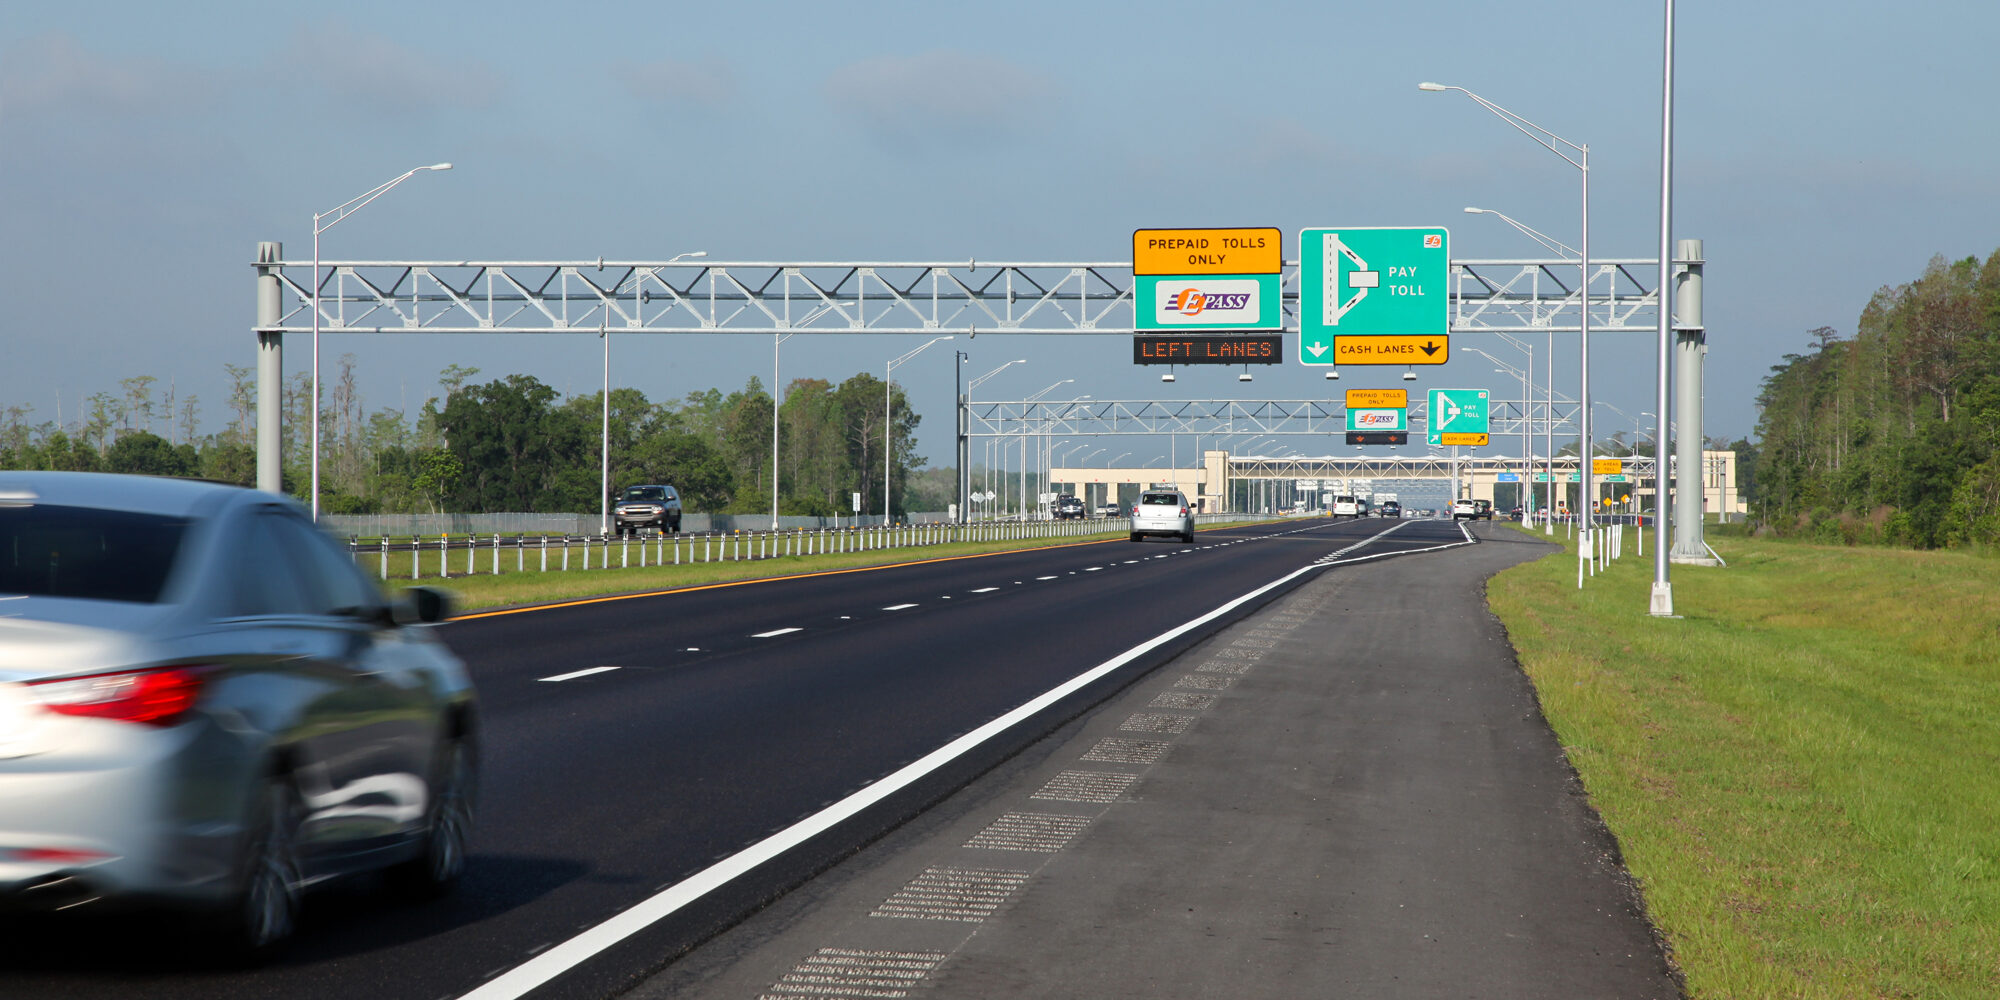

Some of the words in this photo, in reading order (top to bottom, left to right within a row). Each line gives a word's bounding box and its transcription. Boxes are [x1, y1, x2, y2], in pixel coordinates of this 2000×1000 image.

[1149, 239, 1209, 249] PREPAID
[1223, 238, 1265, 248] TOLLS
[1188, 254, 1226, 265] ONLY
[1389, 266, 1417, 277] PAY
[1389, 285, 1425, 296] TOLL
[1142, 342, 1193, 357] LEFT
[1207, 342, 1271, 357] LANES
[1340, 345, 1371, 354] CASH
[1377, 345, 1414, 354] LANES
